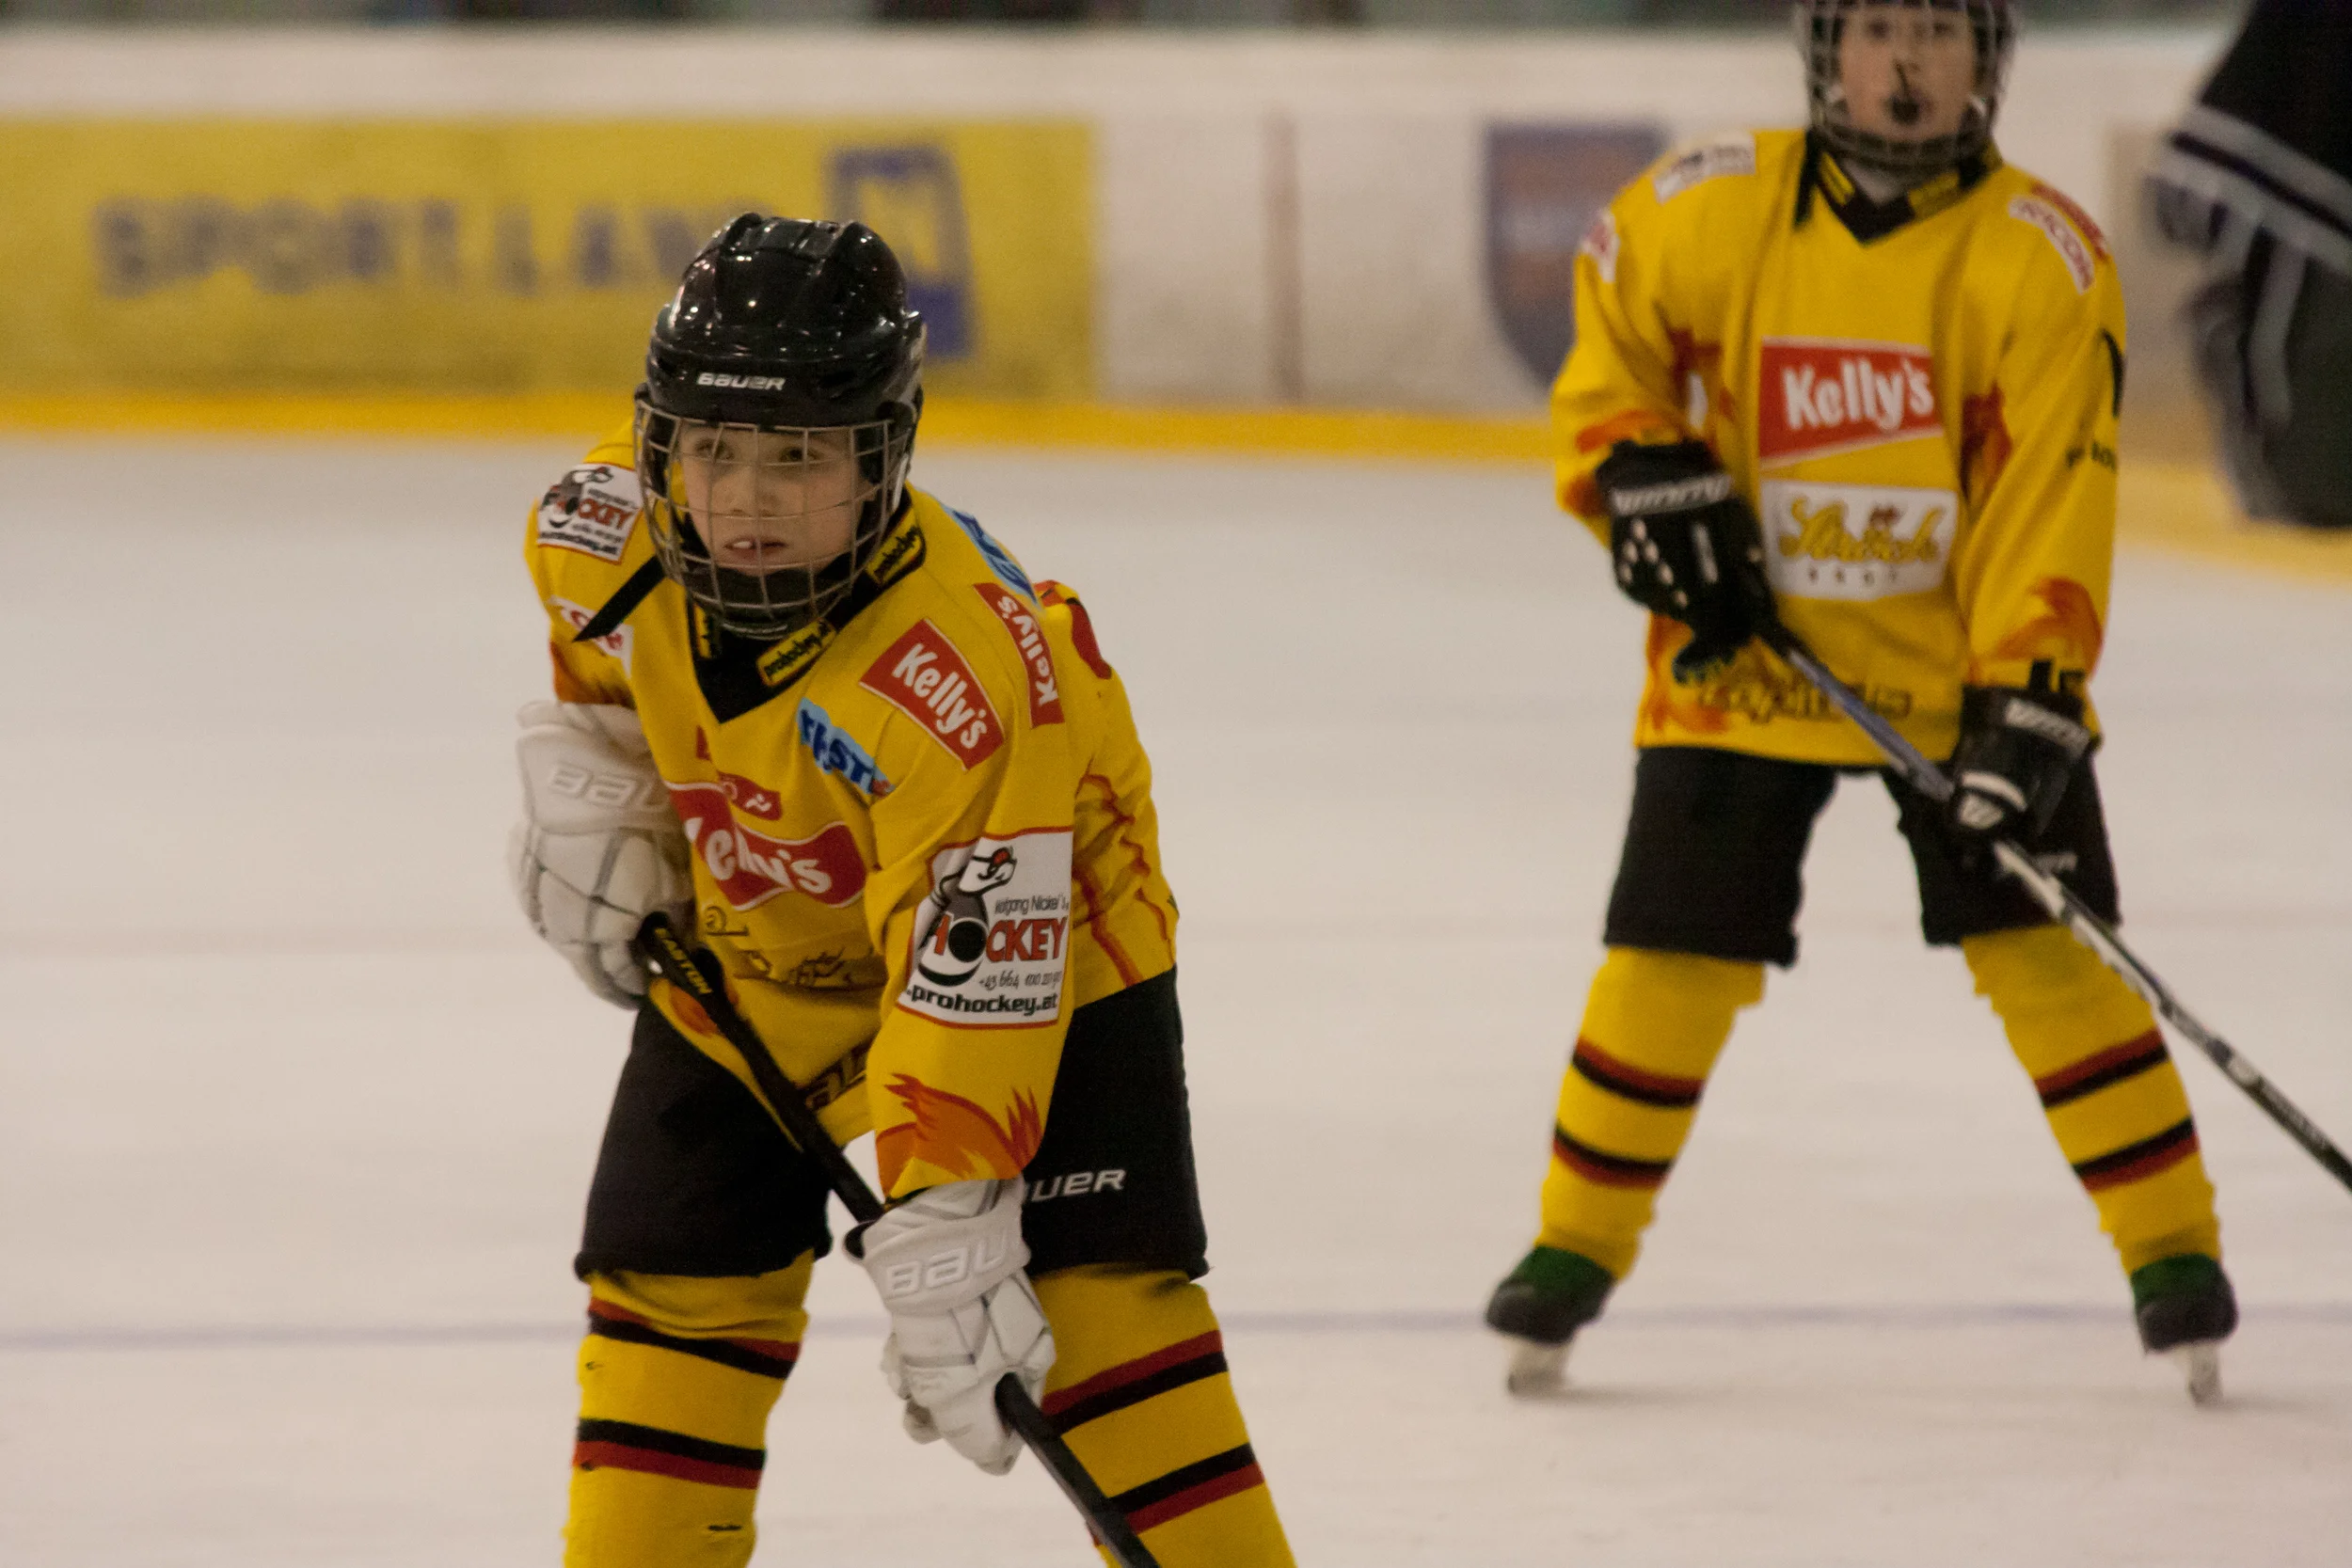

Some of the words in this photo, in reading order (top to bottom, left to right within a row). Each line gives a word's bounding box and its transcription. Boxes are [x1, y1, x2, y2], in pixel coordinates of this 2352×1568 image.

[696, 372, 787, 391] BAUER
[1783, 357, 1935, 431] Kelly's
[996, 594, 1059, 706] Kelly's
[892, 642, 988, 750] Kelly's
